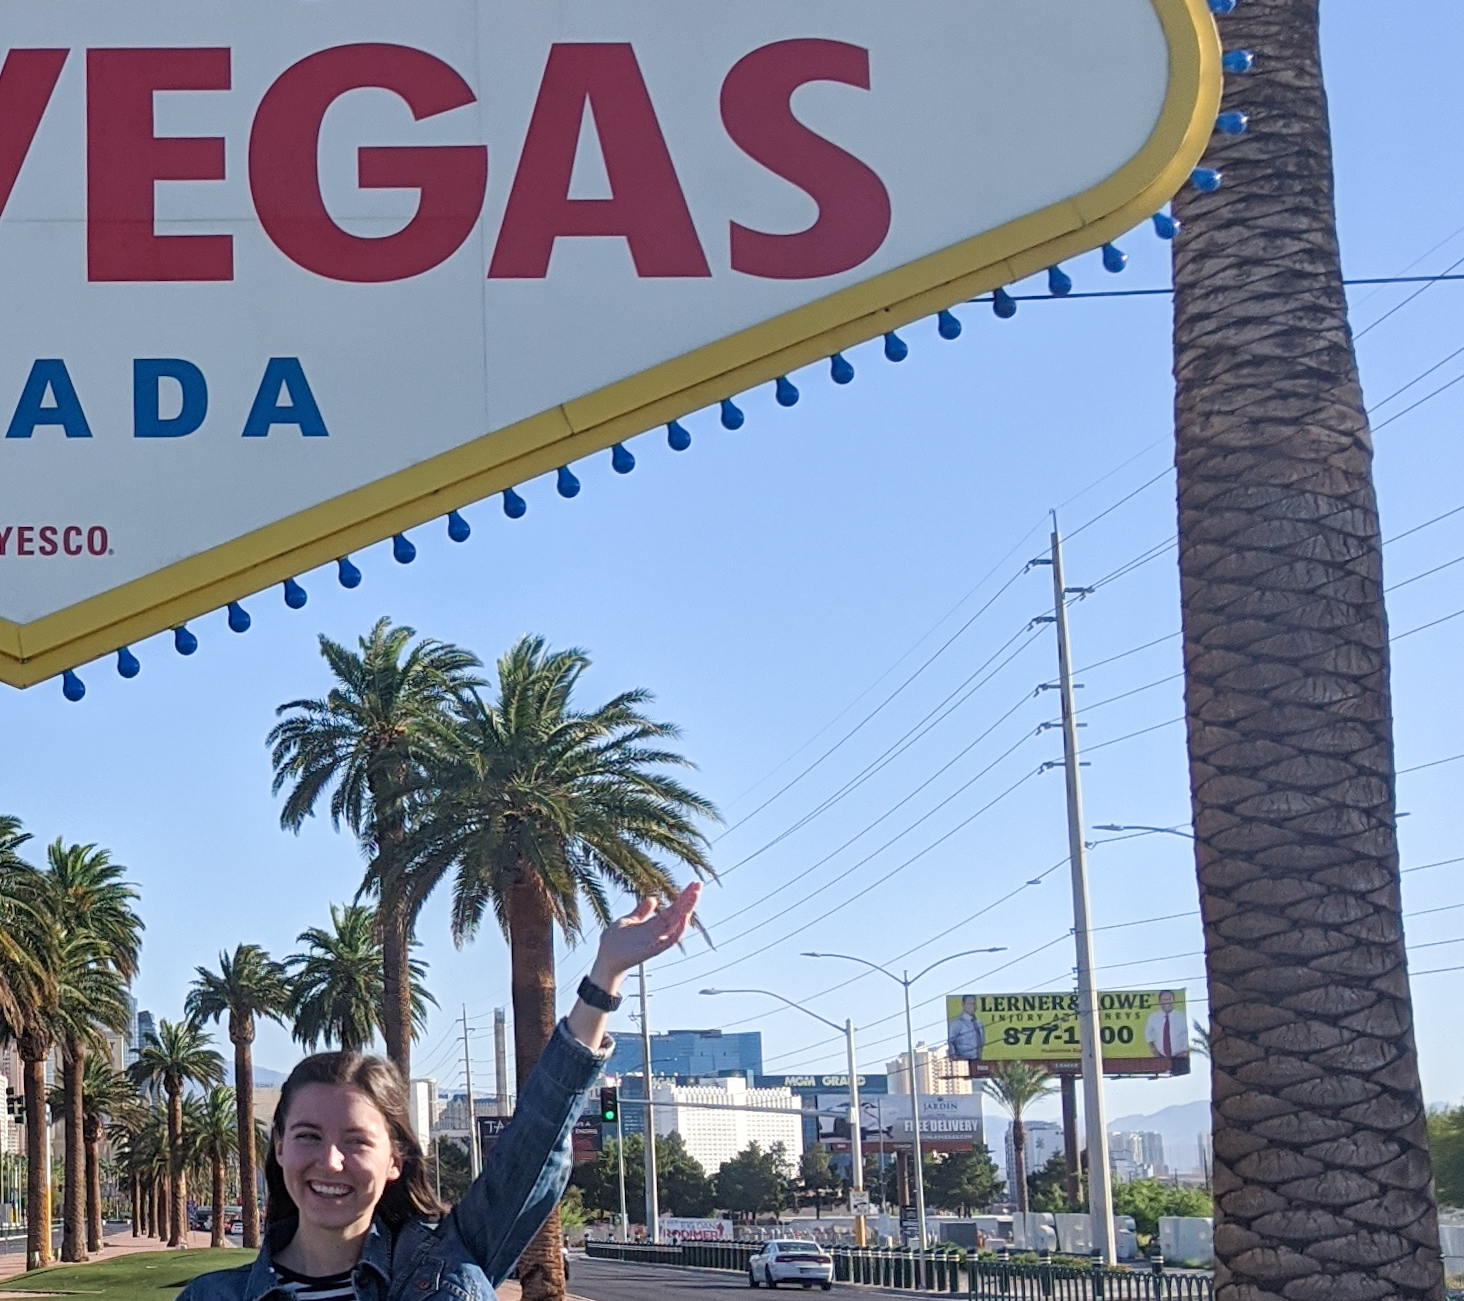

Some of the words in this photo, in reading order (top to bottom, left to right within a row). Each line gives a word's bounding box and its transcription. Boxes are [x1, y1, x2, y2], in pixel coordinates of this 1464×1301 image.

[1003, 1024, 1134, 1046] 877-100
[784, 1075, 816, 1087] MGM
[822, 1074, 866, 1087] GRAD
[923, 1101, 958, 1112] JARDIN
[930, 1119, 978, 1132] DELIVERY
